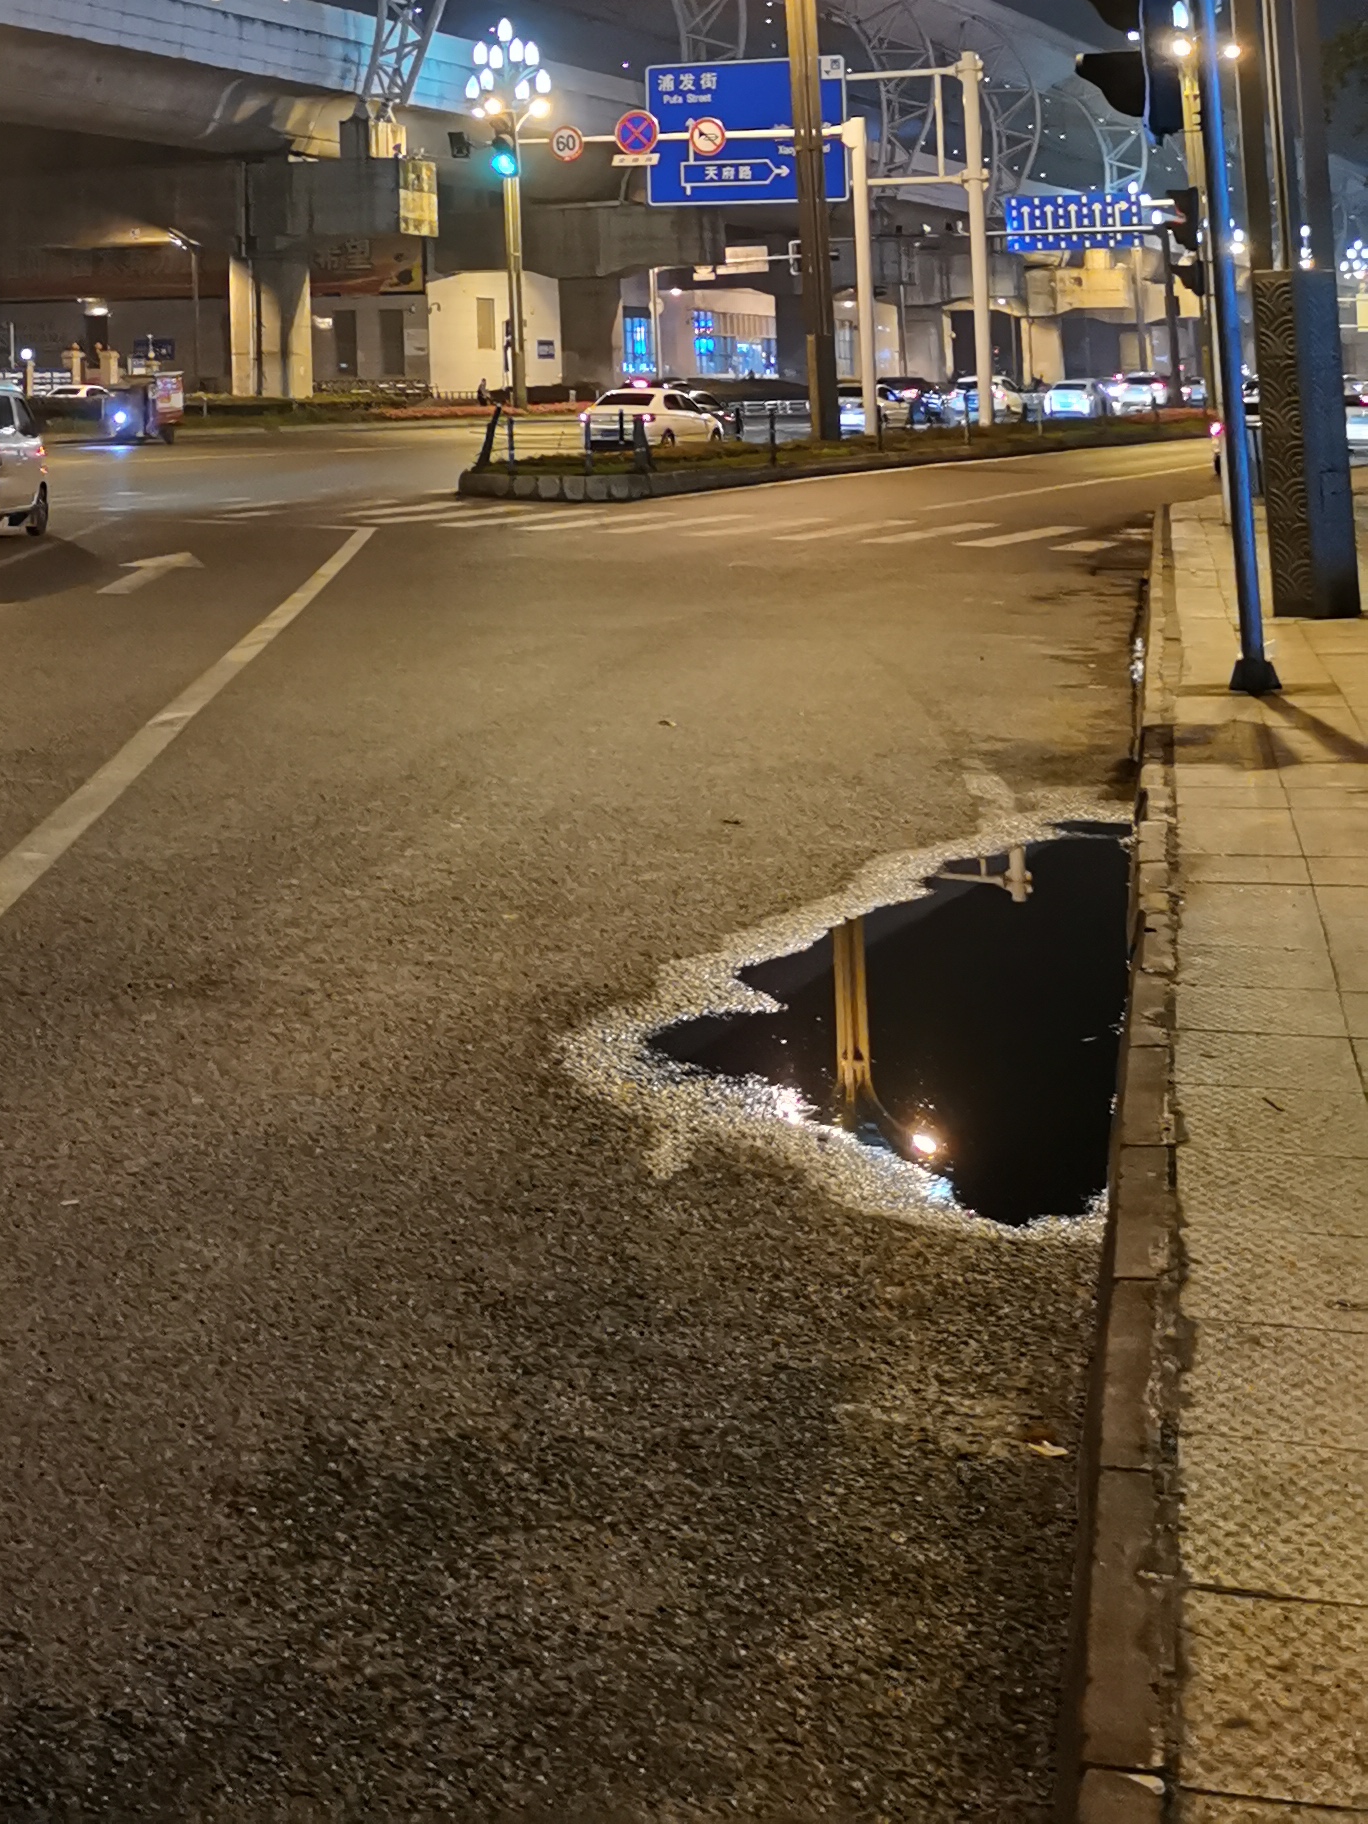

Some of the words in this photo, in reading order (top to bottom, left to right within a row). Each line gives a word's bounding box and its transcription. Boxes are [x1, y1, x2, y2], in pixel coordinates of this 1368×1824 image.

[658, 72, 717, 92] 浦发街
[686, 93, 712, 103] Street
[556, 134, 575, 152] 60
[704, 165, 752, 180] 天府路
